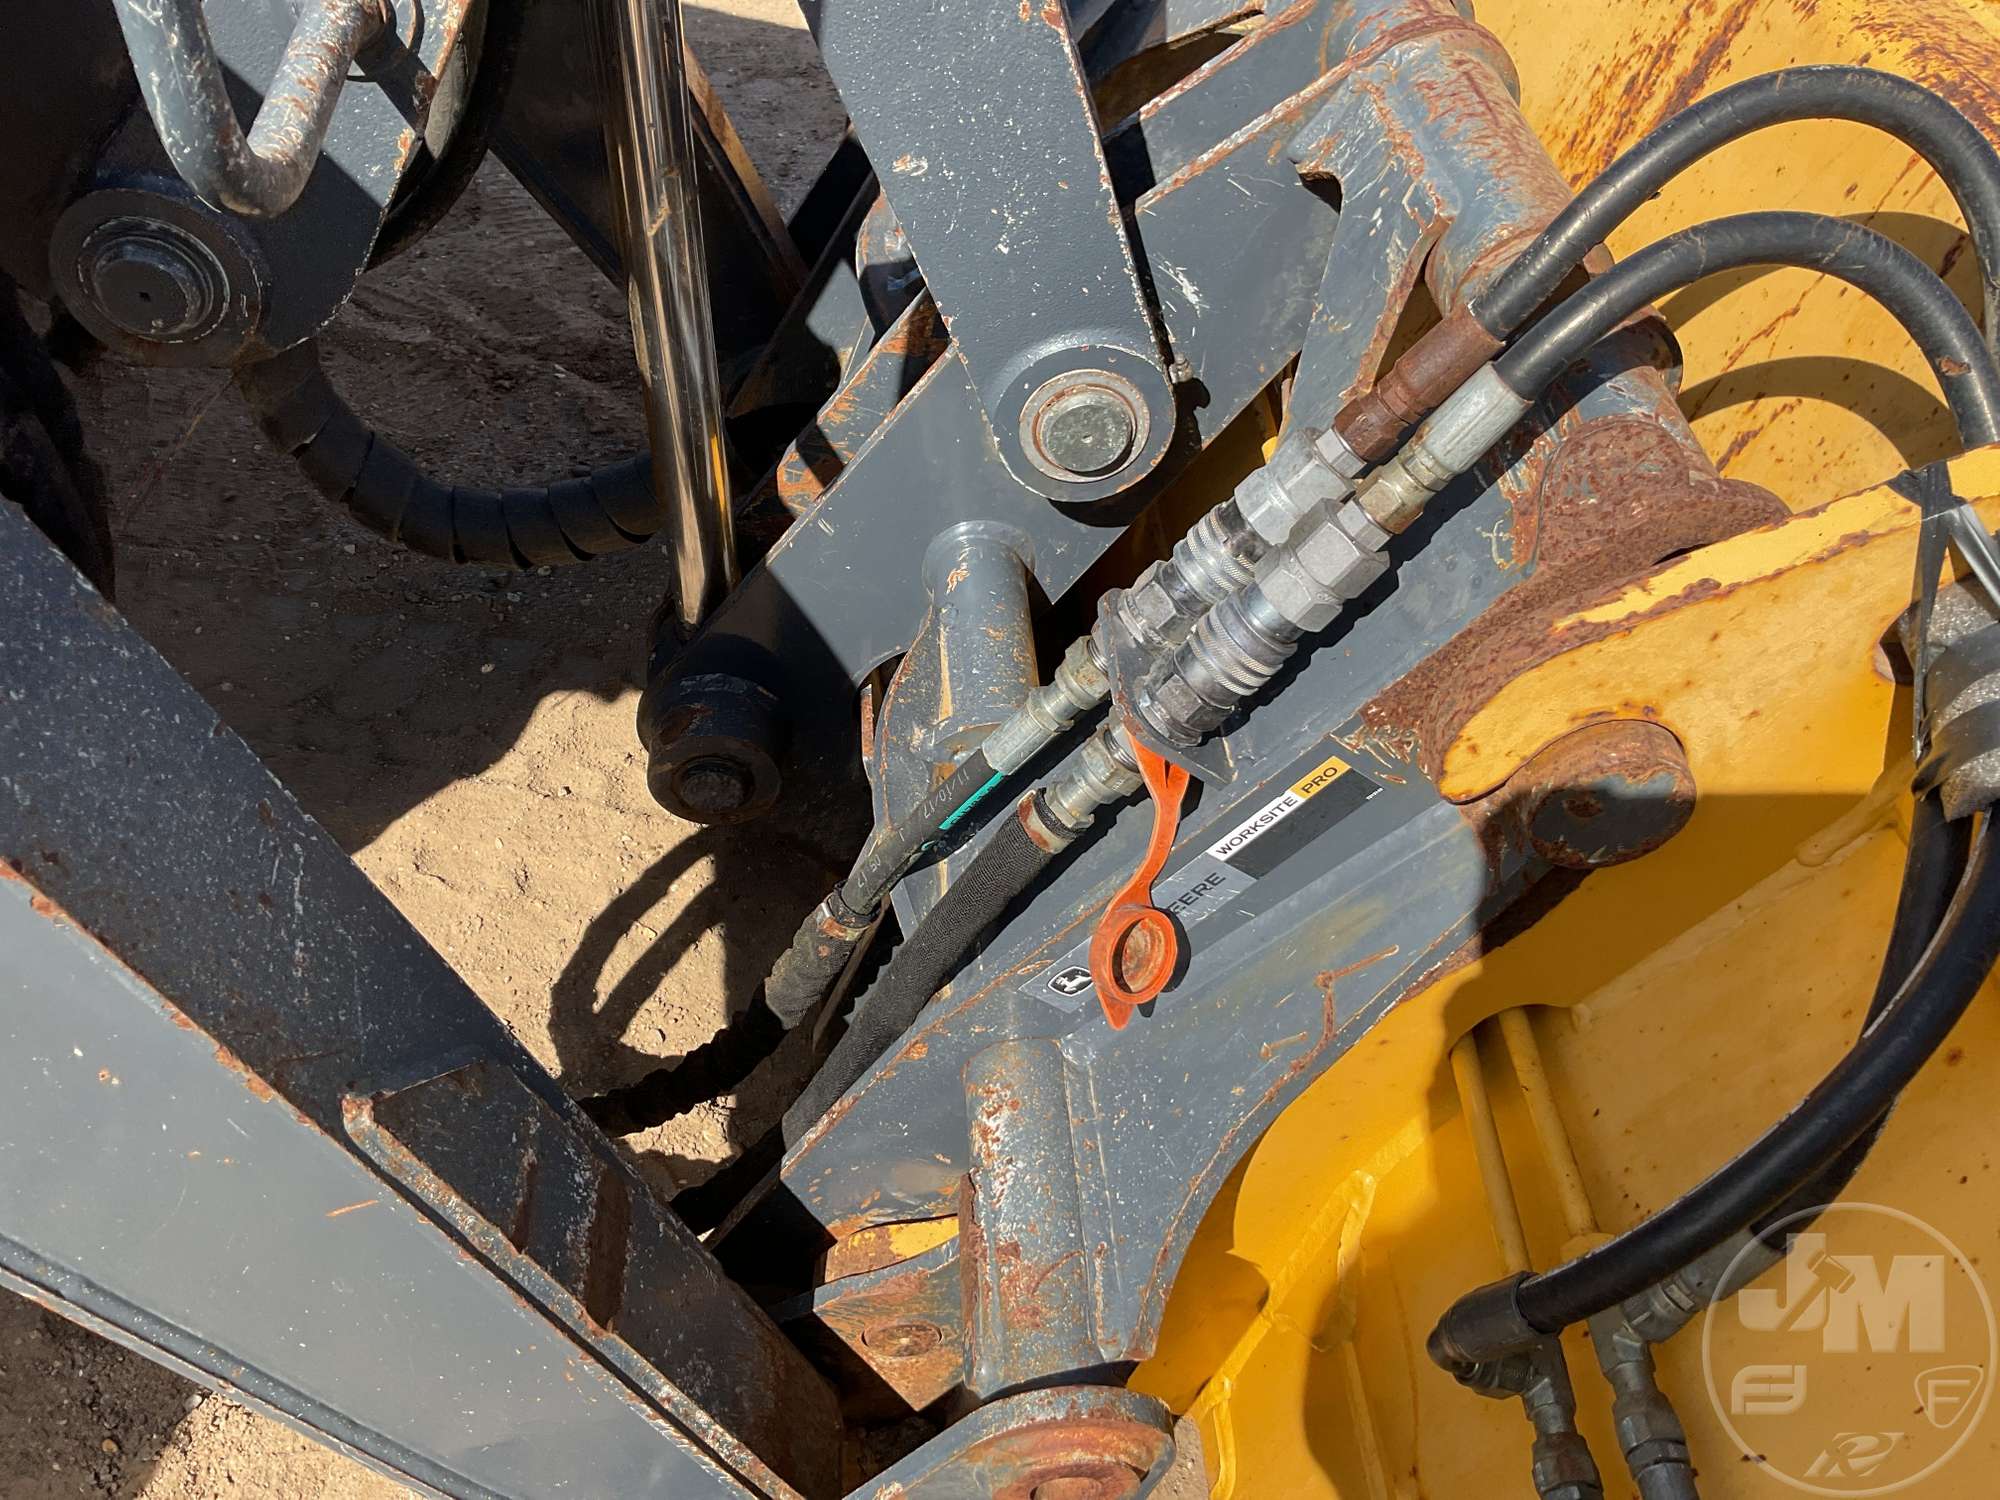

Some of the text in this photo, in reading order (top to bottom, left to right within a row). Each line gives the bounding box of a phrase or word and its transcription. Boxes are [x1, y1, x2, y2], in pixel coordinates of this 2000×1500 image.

[1216, 765, 1339, 857] WORKSITE PRO
[1167, 871, 1227, 915] EERE
